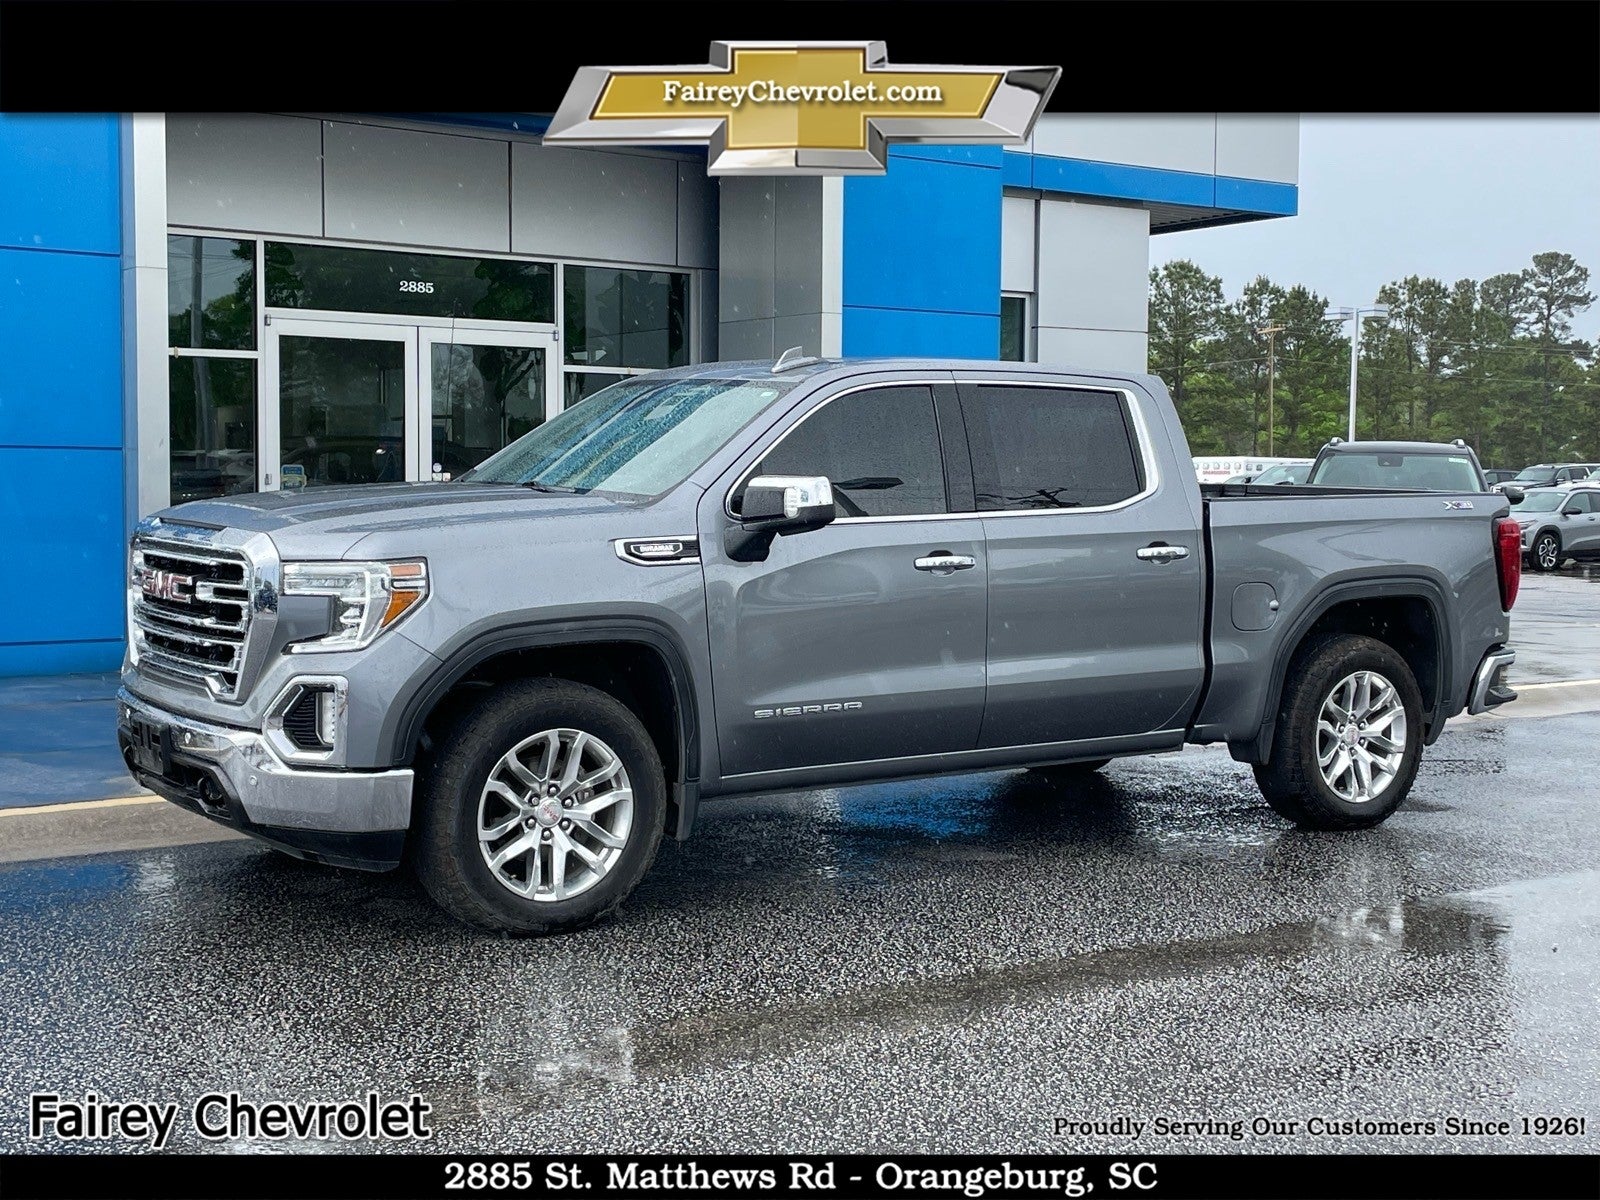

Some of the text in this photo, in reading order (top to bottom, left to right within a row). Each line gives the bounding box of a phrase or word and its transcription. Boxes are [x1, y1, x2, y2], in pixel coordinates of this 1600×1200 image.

[399, 280, 434, 294] 2885
[141, 569, 192, 604] GMC
[754, 701, 862, 719] SIERRA
